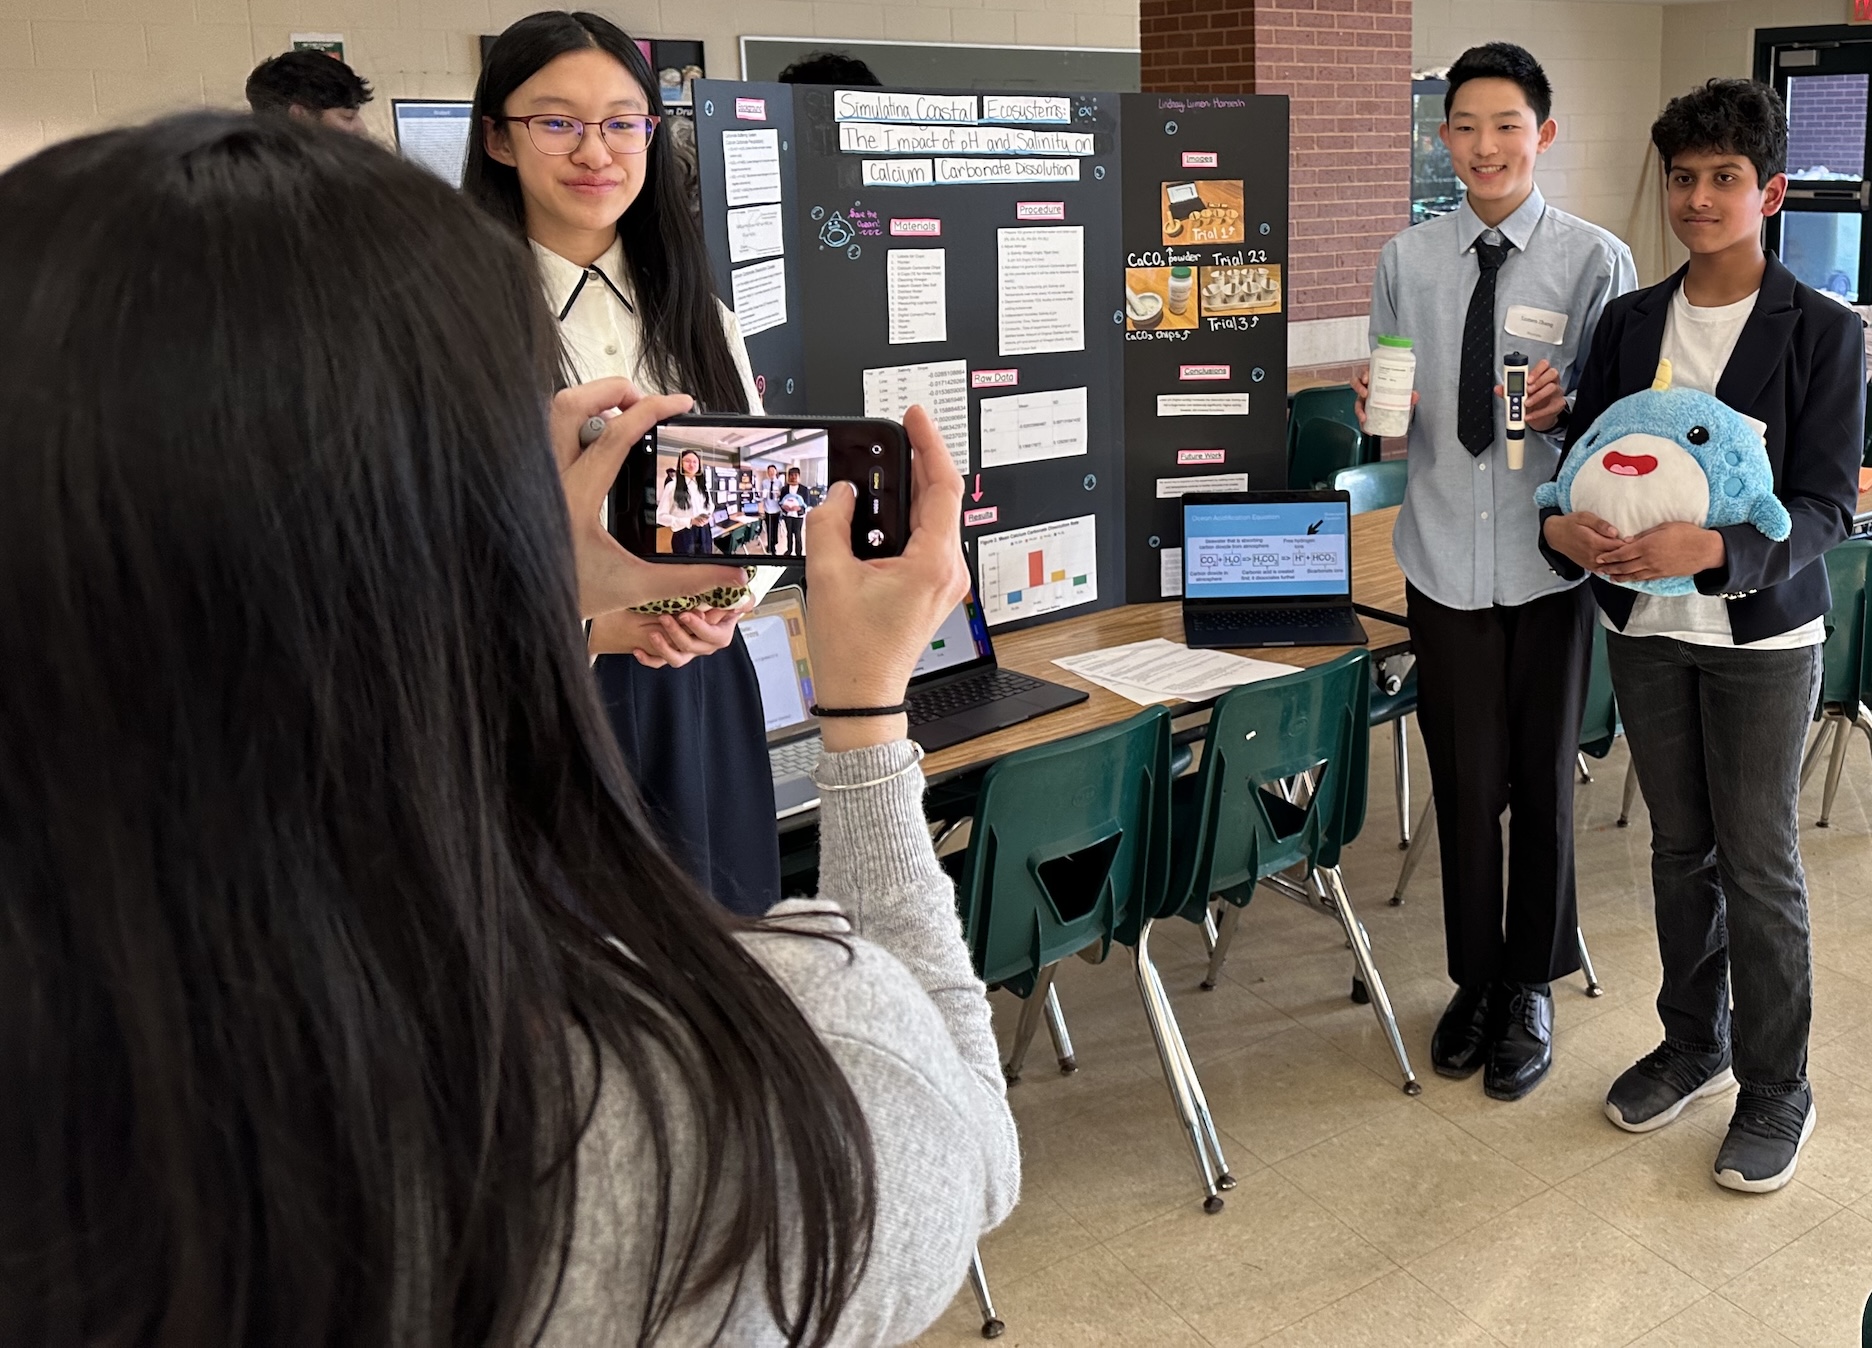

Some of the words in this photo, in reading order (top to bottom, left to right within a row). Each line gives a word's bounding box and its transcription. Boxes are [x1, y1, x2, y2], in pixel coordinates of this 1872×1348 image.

[839, 92, 912, 122] Simulating
[917, 96, 972, 122] Coastal
[988, 99, 1067, 121] Ecosystems:
[842, 127, 879, 150] The
[884, 128, 939, 151] Impact
[942, 128, 955, 150] of
[961, 130, 979, 152] pH
[986, 132, 1011, 152] and
[1016, 130, 1071, 155] Salinity
[1075, 137, 1092, 154] on
[1186, 154, 1213, 164] Images
[870, 162, 925, 184] Calcium
[941, 159, 1011, 180] Carbonate
[1016, 160, 1074, 177] Dissolution
[848, 208, 866, 219] Save
[867, 209, 878, 219] the
[1020, 205, 1062, 215] Procedure
[894, 221, 936, 231] Materials
[1192, 226, 1218, 242] Trial
[1221, 227, 1229, 240] 1
[1127, 251, 1165, 267] CaCO3
[1168, 251, 1202, 266] powder
[1212, 251, 1244, 266] Trial
[1207, 317, 1238, 332] Trial
[1238, 317, 1249, 331] 3
[1156, 331, 1181, 342] chips
[1184, 367, 1227, 376] Conclusions
[975, 374, 992, 383] Raw
[994, 373, 1014, 383] Data
[1180, 452, 1203, 461] Future
[1204, 451, 1222, 460] Work
[968, 511, 993, 523] Results
[1200, 556, 1216, 567] CO2
[1224, 555, 1240, 566] H2O
